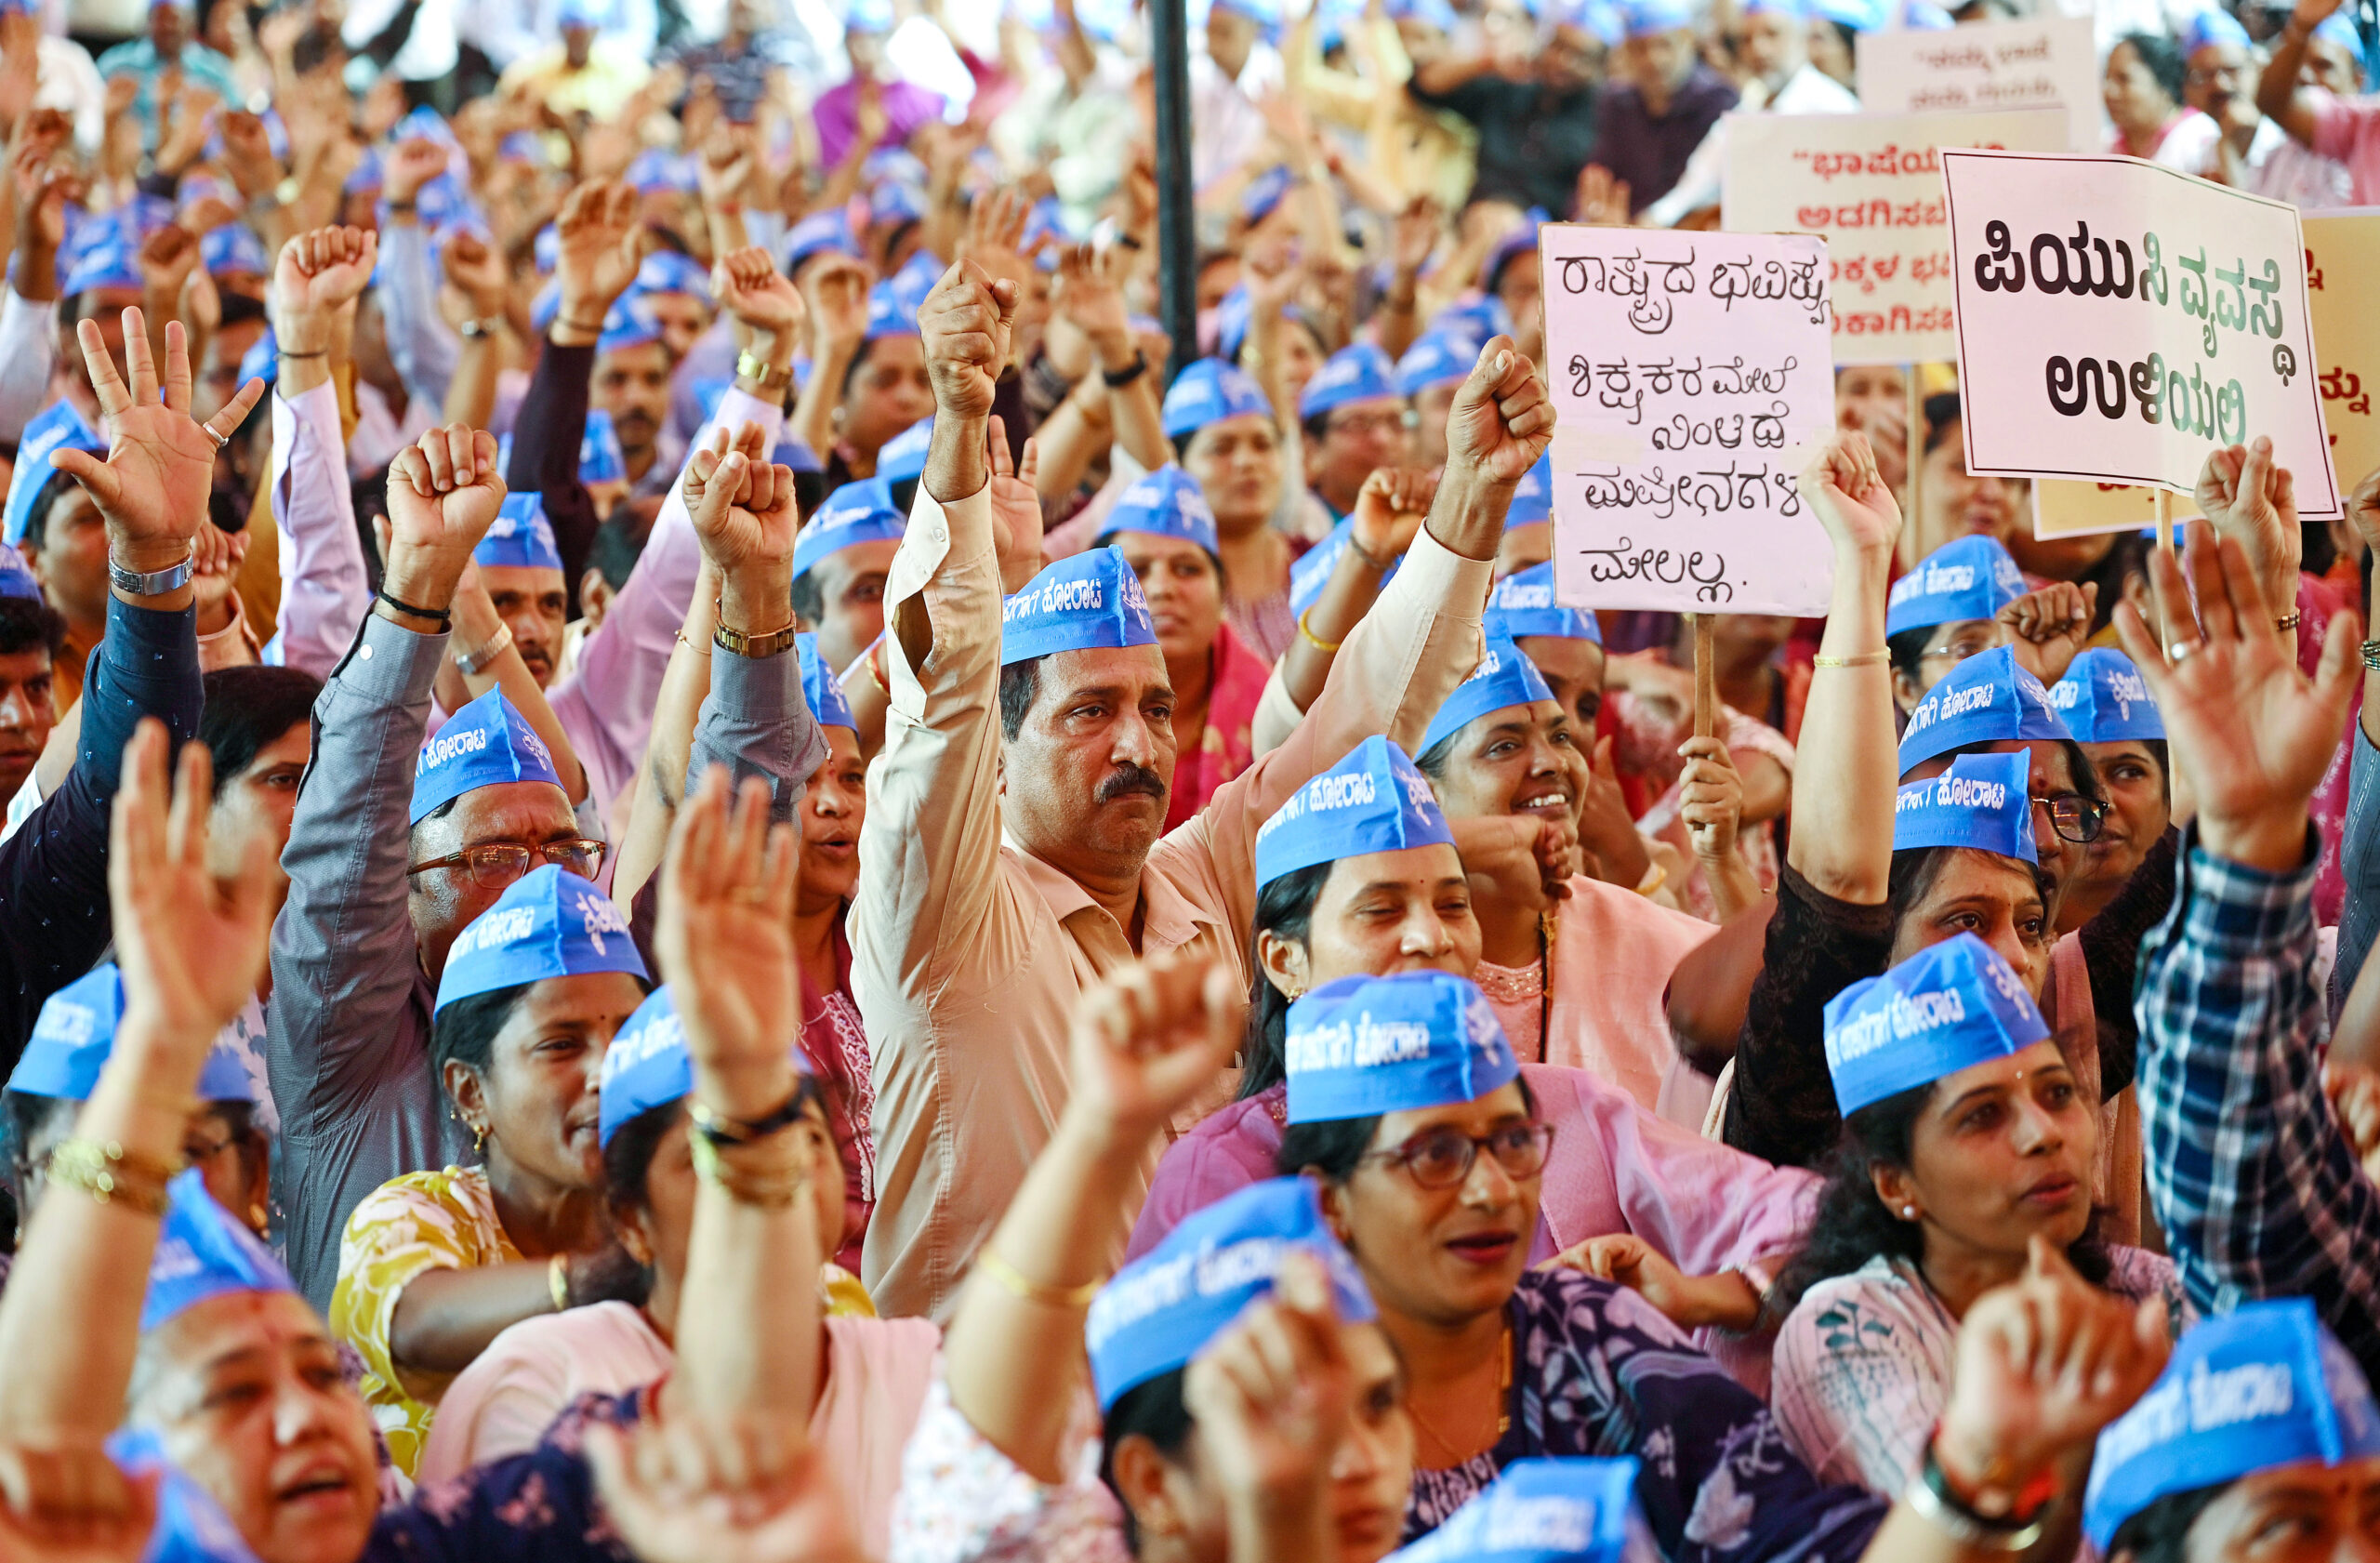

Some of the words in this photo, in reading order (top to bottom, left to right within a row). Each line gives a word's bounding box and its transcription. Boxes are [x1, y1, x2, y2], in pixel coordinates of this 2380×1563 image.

[1554, 245, 1696, 335] ರಾಷ್ಟ್ರದ
[1709, 254, 1832, 325] ಭವಿಷ್ಯ
[1975, 219, 2169, 307] ಪಿಯುಸಿ
[2178, 245, 2297, 387] ವ್ಯವಸ್ಥೆ
[1568, 354, 1702, 425] ಶಿಕ್ಷಕರ
[1707, 355, 1798, 395] ಮೇಲೆ
[2045, 352, 2247, 445] ಉಳಿಯಲಿ
[1042, 576, 1103, 614] ಹೋರಾಟ
[1940, 682, 1993, 722] ಹೋರಾಟ
[425, 727, 486, 770] ಹೋರಾಟ
[1309, 771, 1376, 813] ಹೋರಾಟ
[1937, 767, 2005, 811] ಹೋರಾಟ
